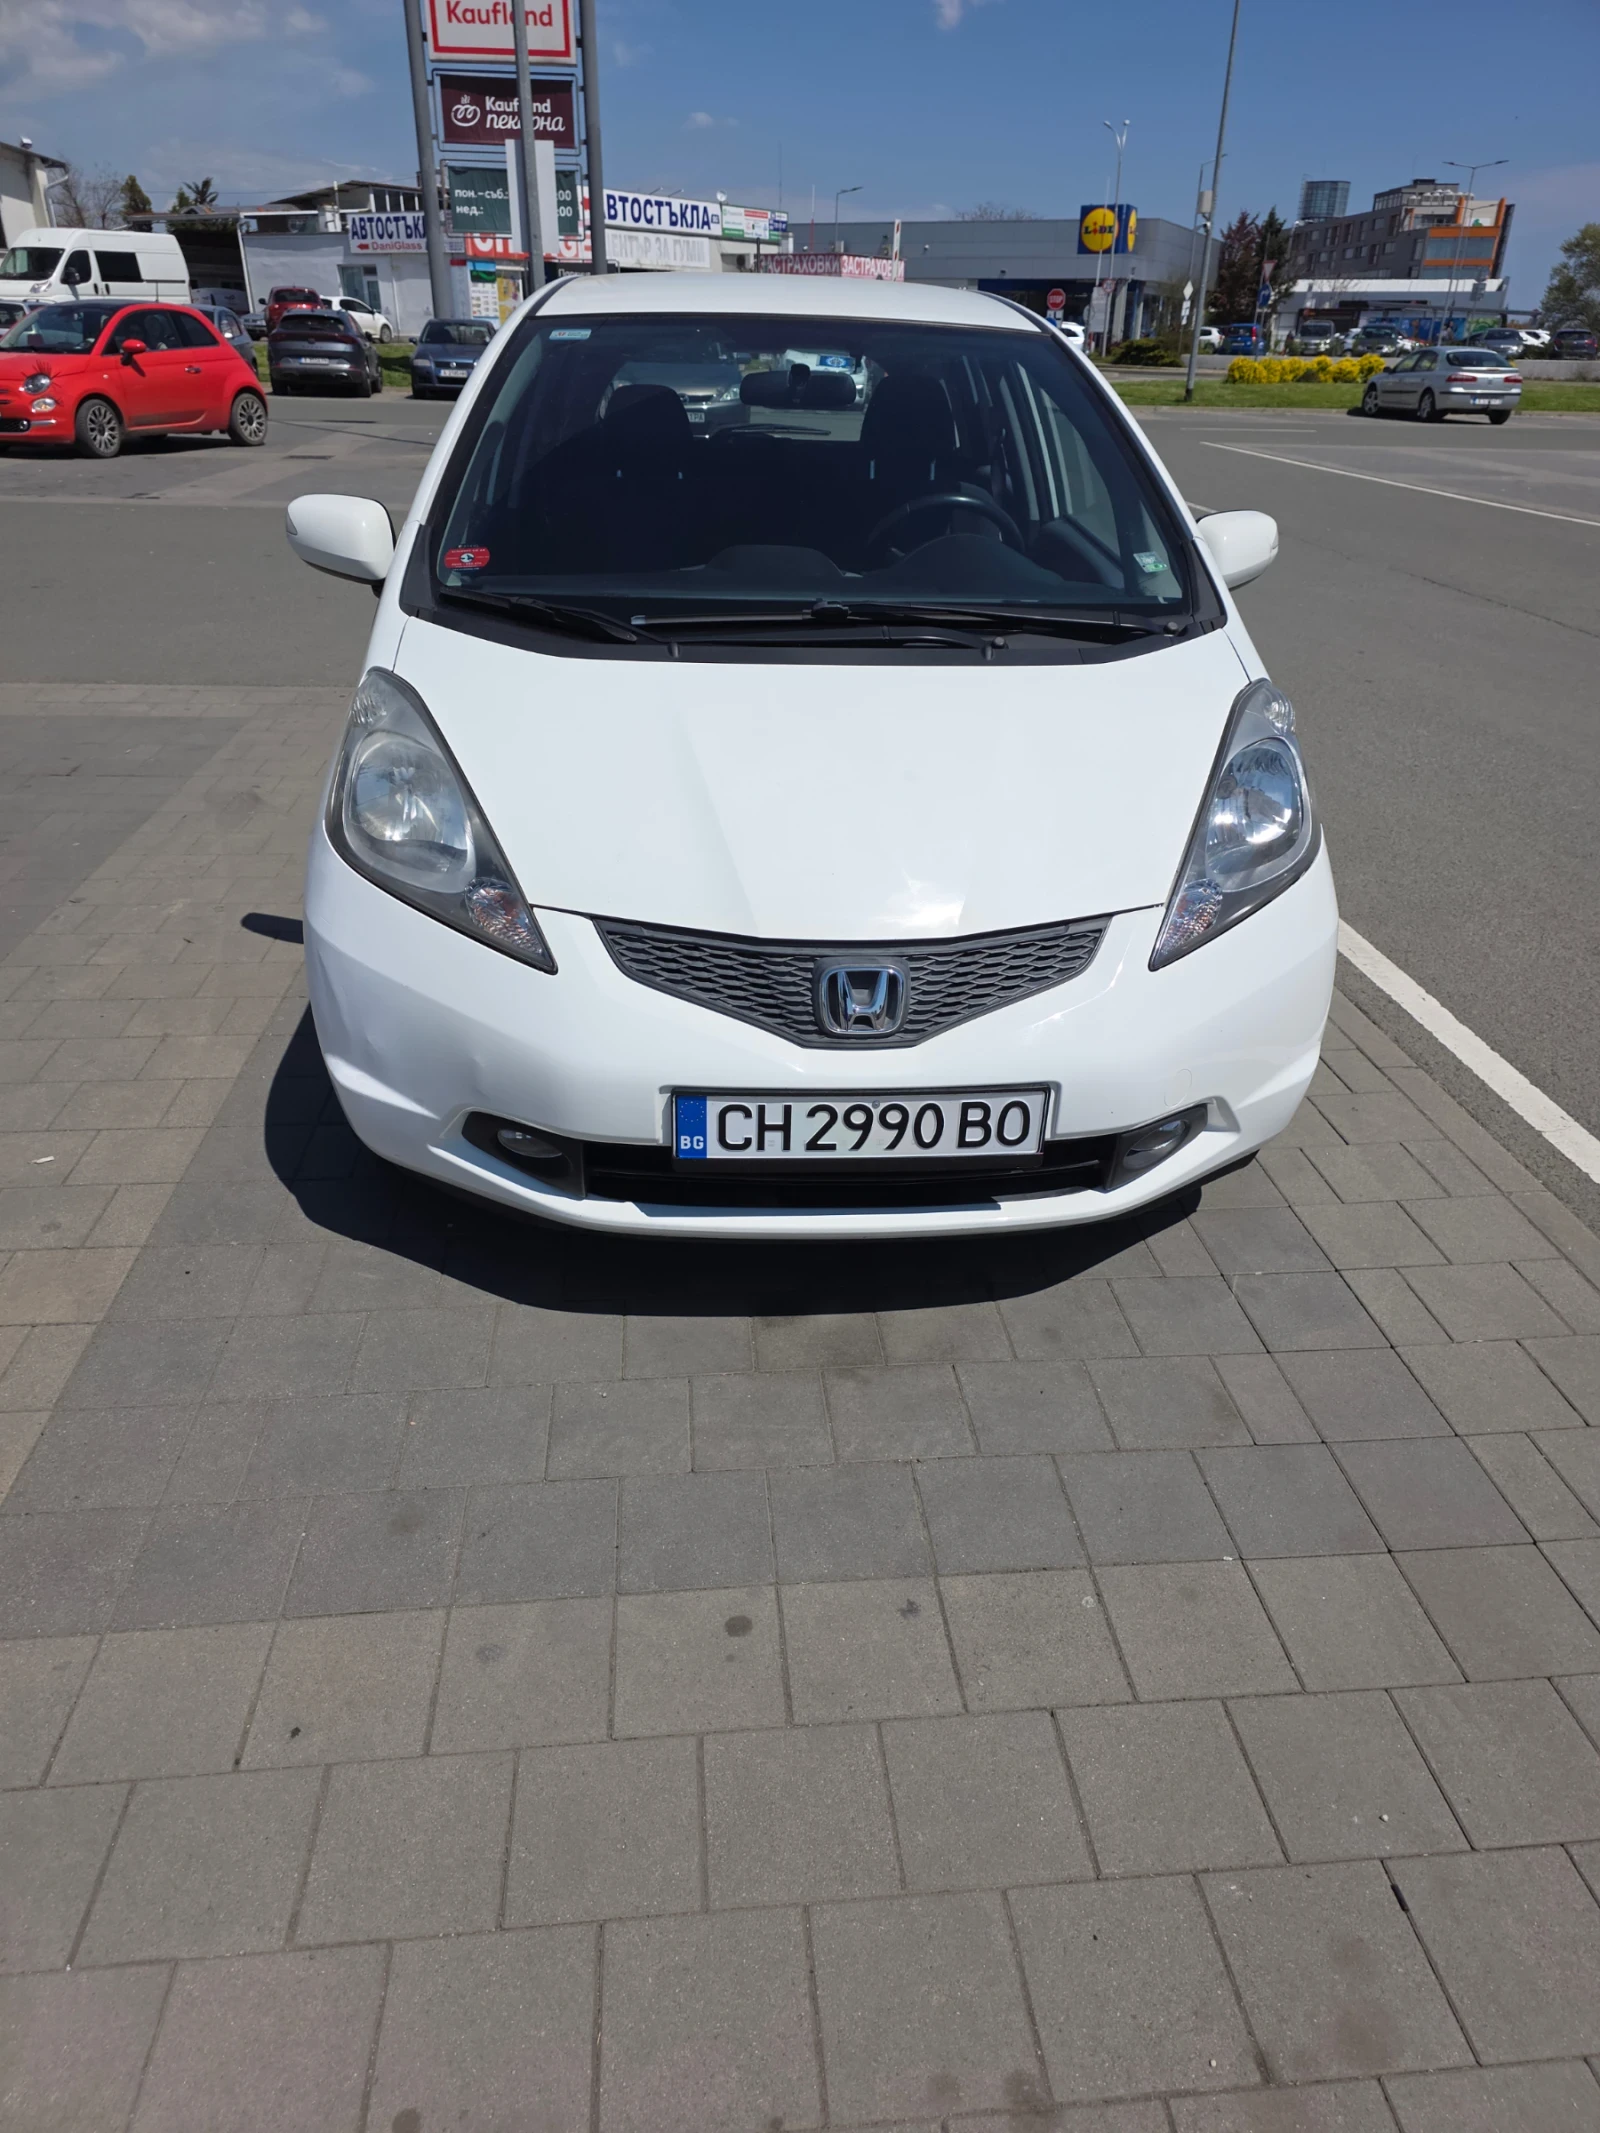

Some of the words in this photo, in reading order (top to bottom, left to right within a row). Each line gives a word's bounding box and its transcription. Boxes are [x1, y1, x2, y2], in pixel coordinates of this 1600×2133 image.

[446, 0, 553, 27] Kauflnd
[485, 96, 552, 113] Kaufnd
[604, 194, 711, 230] ВТОСТЪКЛА
[371, 241, 422, 251] DaniGlass
[760, 255, 839, 274] ЗАСТРАХОВКИ
[1049, 295, 1064, 303] STOP
[805, 1102, 945, 1152] 2990
[680, 1135, 705, 1151] BG
